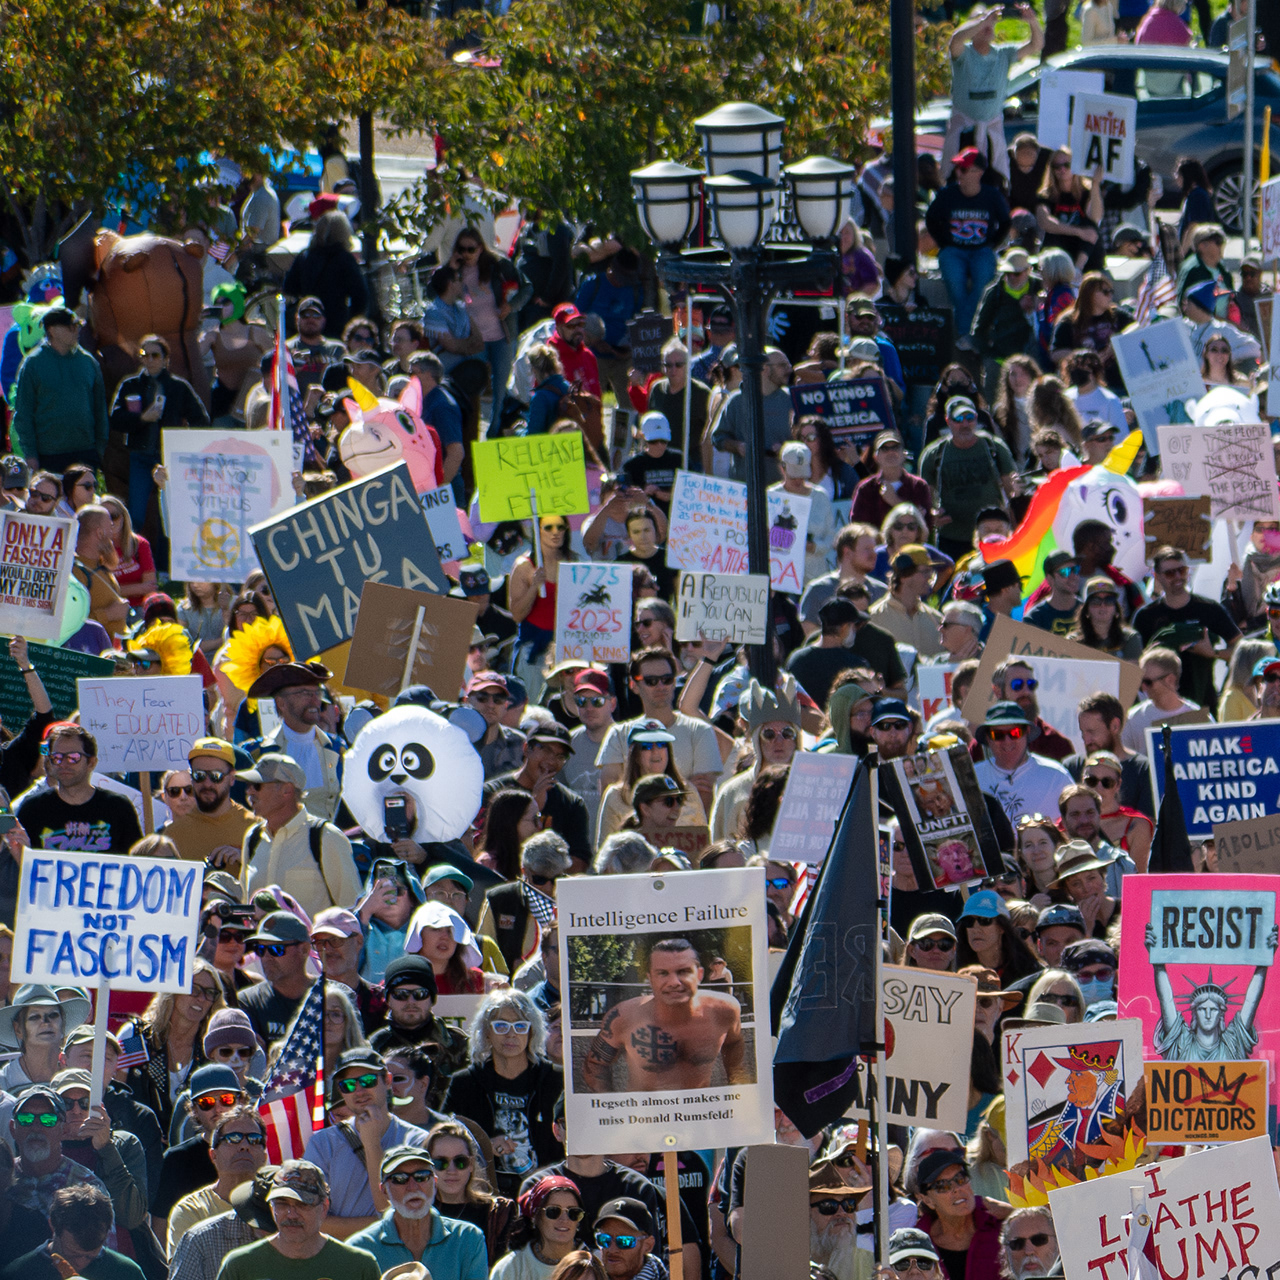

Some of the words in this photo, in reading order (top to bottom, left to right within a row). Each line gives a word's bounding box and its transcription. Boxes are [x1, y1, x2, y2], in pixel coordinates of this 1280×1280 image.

[1085, 111, 1127, 137] ANTIFA
[1085, 139, 1122, 171] AF
[496, 437, 584, 472] RELEASE
[515, 468, 563, 492] THE
[508, 488, 576, 517] FILES
[6, 521, 49, 548] ONLY
[52, 528, 64, 550] A
[266, 474, 421, 572] CHINGA
[2, 546, 62, 570] FASCIST
[315, 532, 383, 587] TU
[571, 565, 620, 586] 1775
[568, 610, 623, 632] 2025
[1173, 757, 1280, 780] AMERICA
[1199, 780, 1257, 801] KIND
[917, 813, 968, 834] UNFIT
[1192, 802, 1266, 825] AGAIN
[30, 859, 196, 916] FREEDOM
[83, 912, 131, 931] NOT
[569, 906, 679, 930] Intelligence
[684, 902, 748, 924] Failure
[1161, 905, 1263, 951] RESIST
[25, 929, 189, 988] FASCISM
[884, 979, 964, 1025] SAY
[1151, 1066, 1193, 1104] NO
[591, 1097, 640, 1111] Hegseth
[642, 1094, 679, 1107] almost
[683, 1093, 720, 1105] makes
[723, 1093, 741, 1104] me
[598, 1114, 624, 1126] miss
[627, 1111, 670, 1125] Donald
[674, 1108, 734, 1123] Rumsfeld!
[1149, 1106, 1256, 1134] DICTATORS
